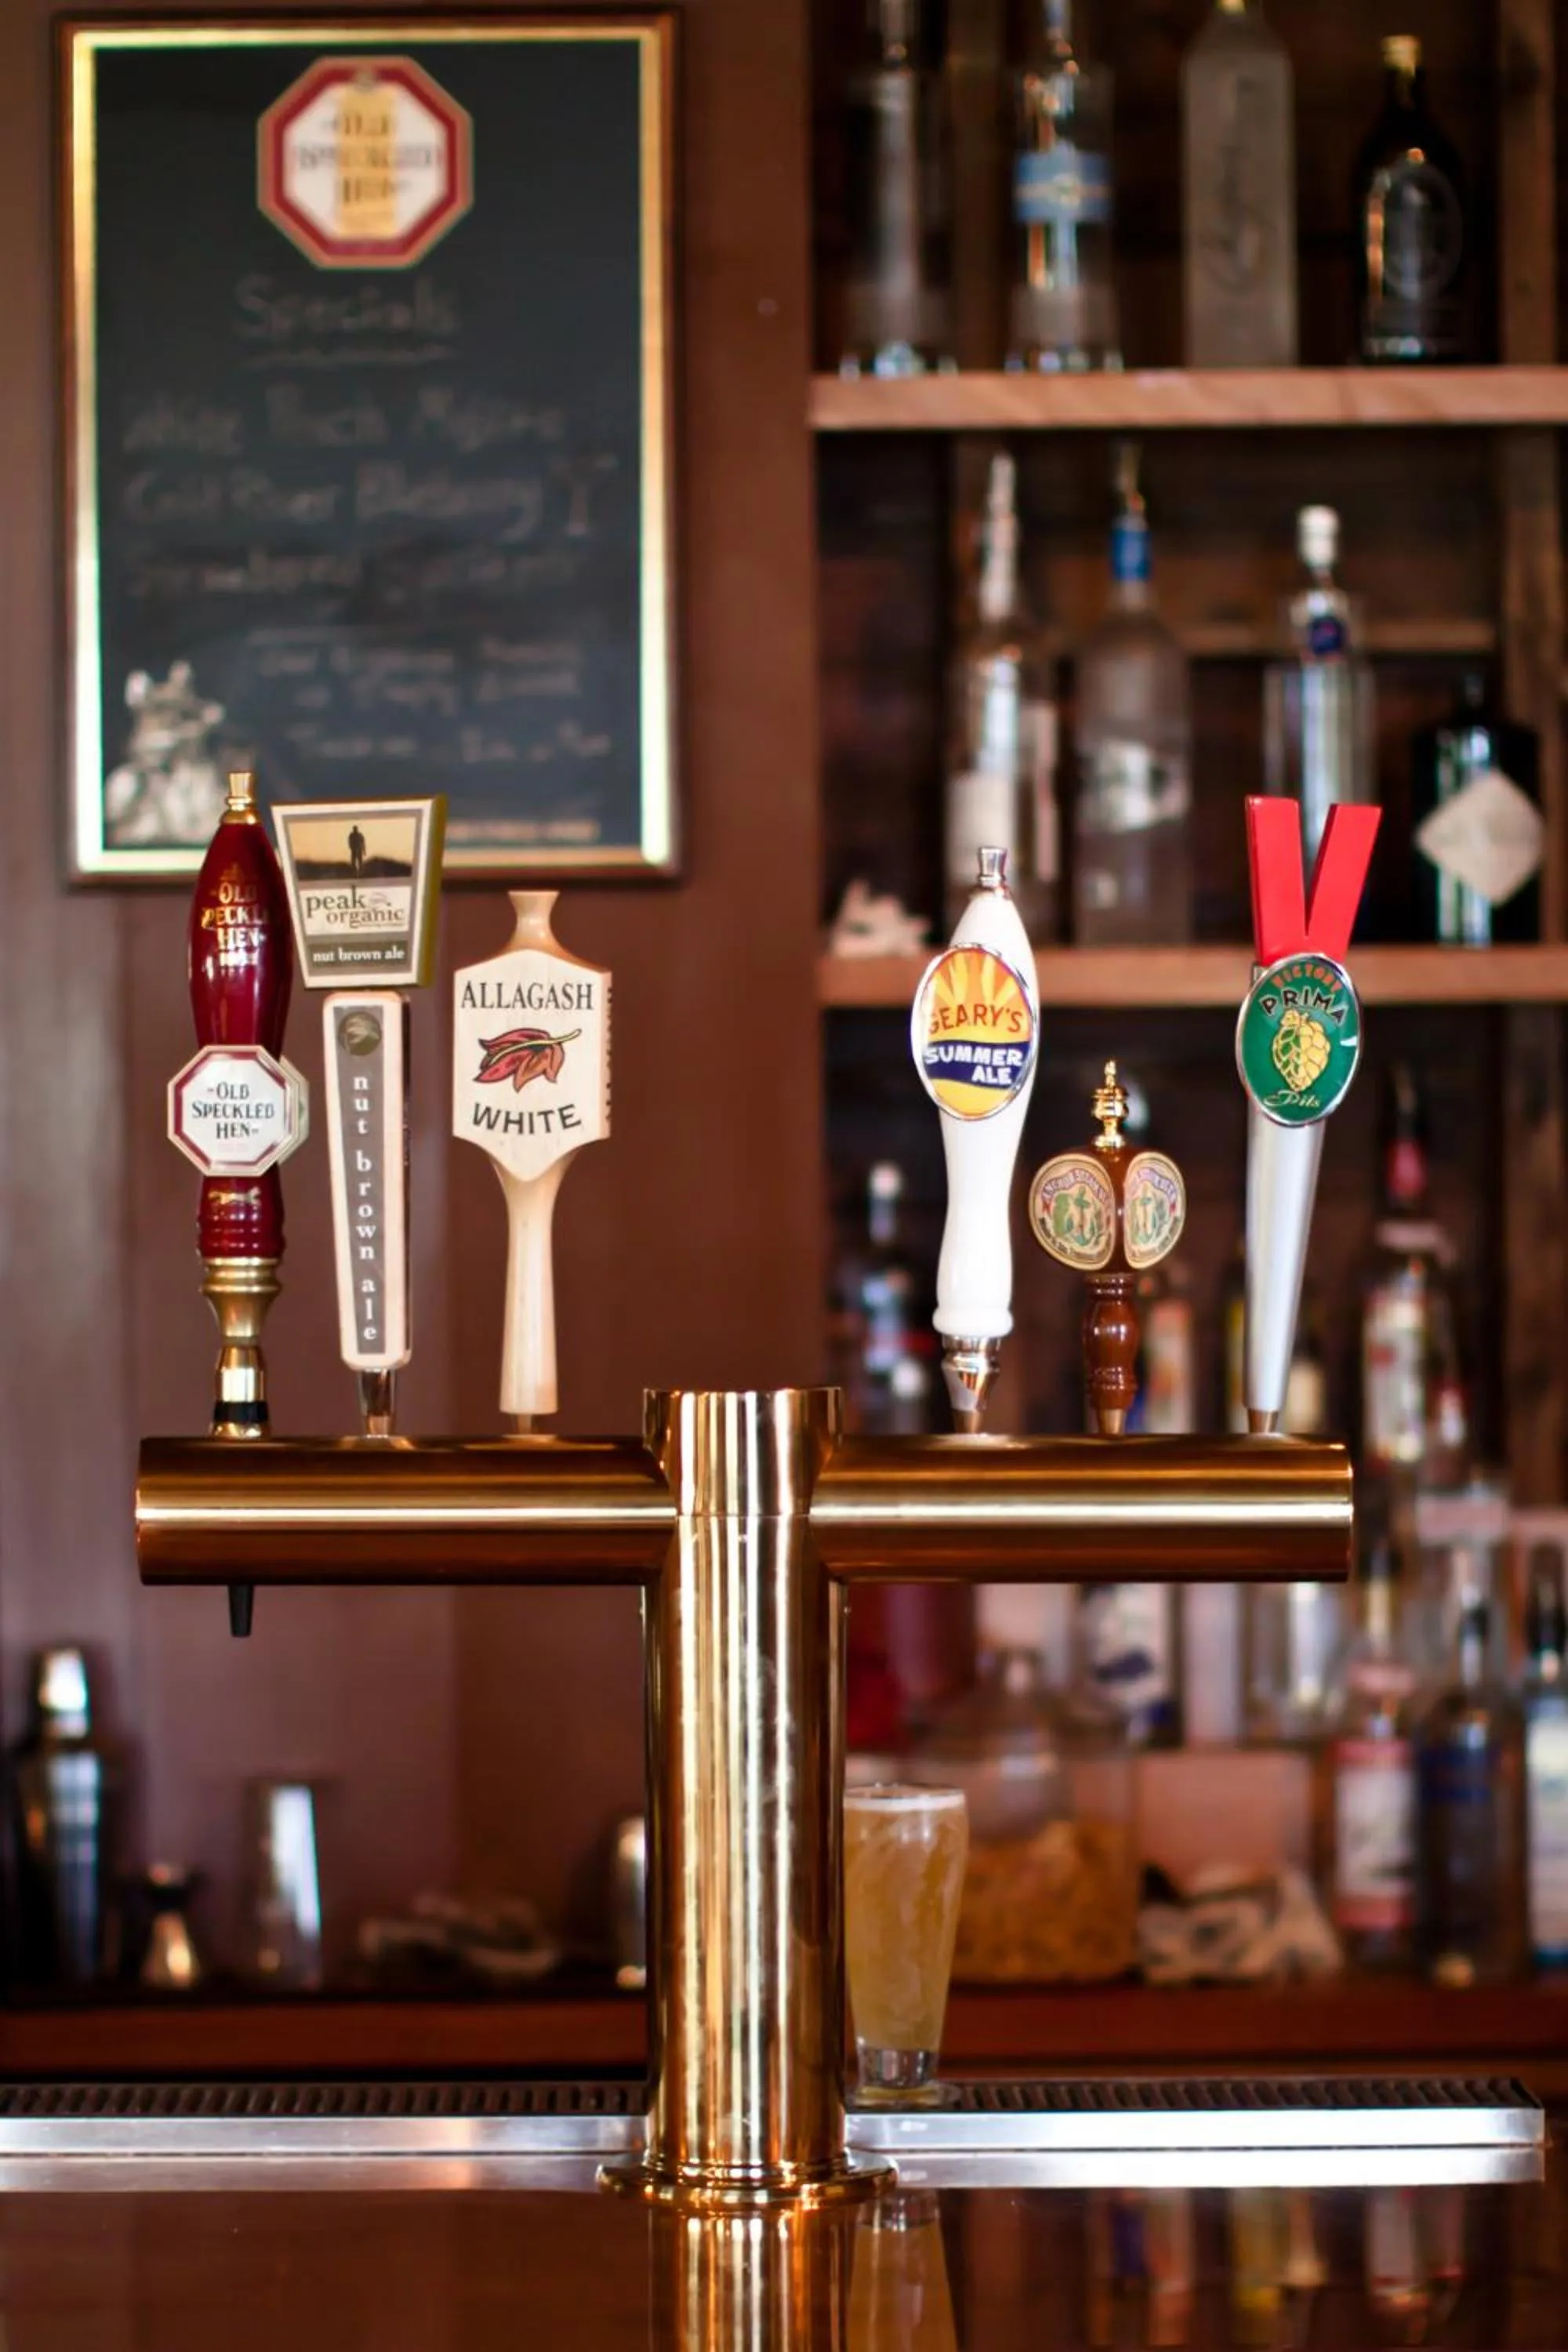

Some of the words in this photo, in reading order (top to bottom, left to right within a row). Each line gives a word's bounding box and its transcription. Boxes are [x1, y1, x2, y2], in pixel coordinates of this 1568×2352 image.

[306, 885, 366, 918] peak
[326, 902, 405, 928] organic
[313, 951, 335, 962] nut
[338, 947, 382, 961] brown
[384, 946, 405, 960] ale
[461, 981, 594, 1010] ALLAGASH
[1259, 986, 1348, 1026] PRIMA
[924, 1044, 1023, 1066] SUMMER
[971, 1065, 1012, 1084] ALE
[191, 1102, 274, 1120] SPECKLED
[353, 1076, 370, 1134] nut
[1264, 1089, 1321, 1108] Pils
[472, 1102, 582, 1134] WHITE
[355, 1149, 377, 1260] brown
[361, 1279, 377, 1340] ale
